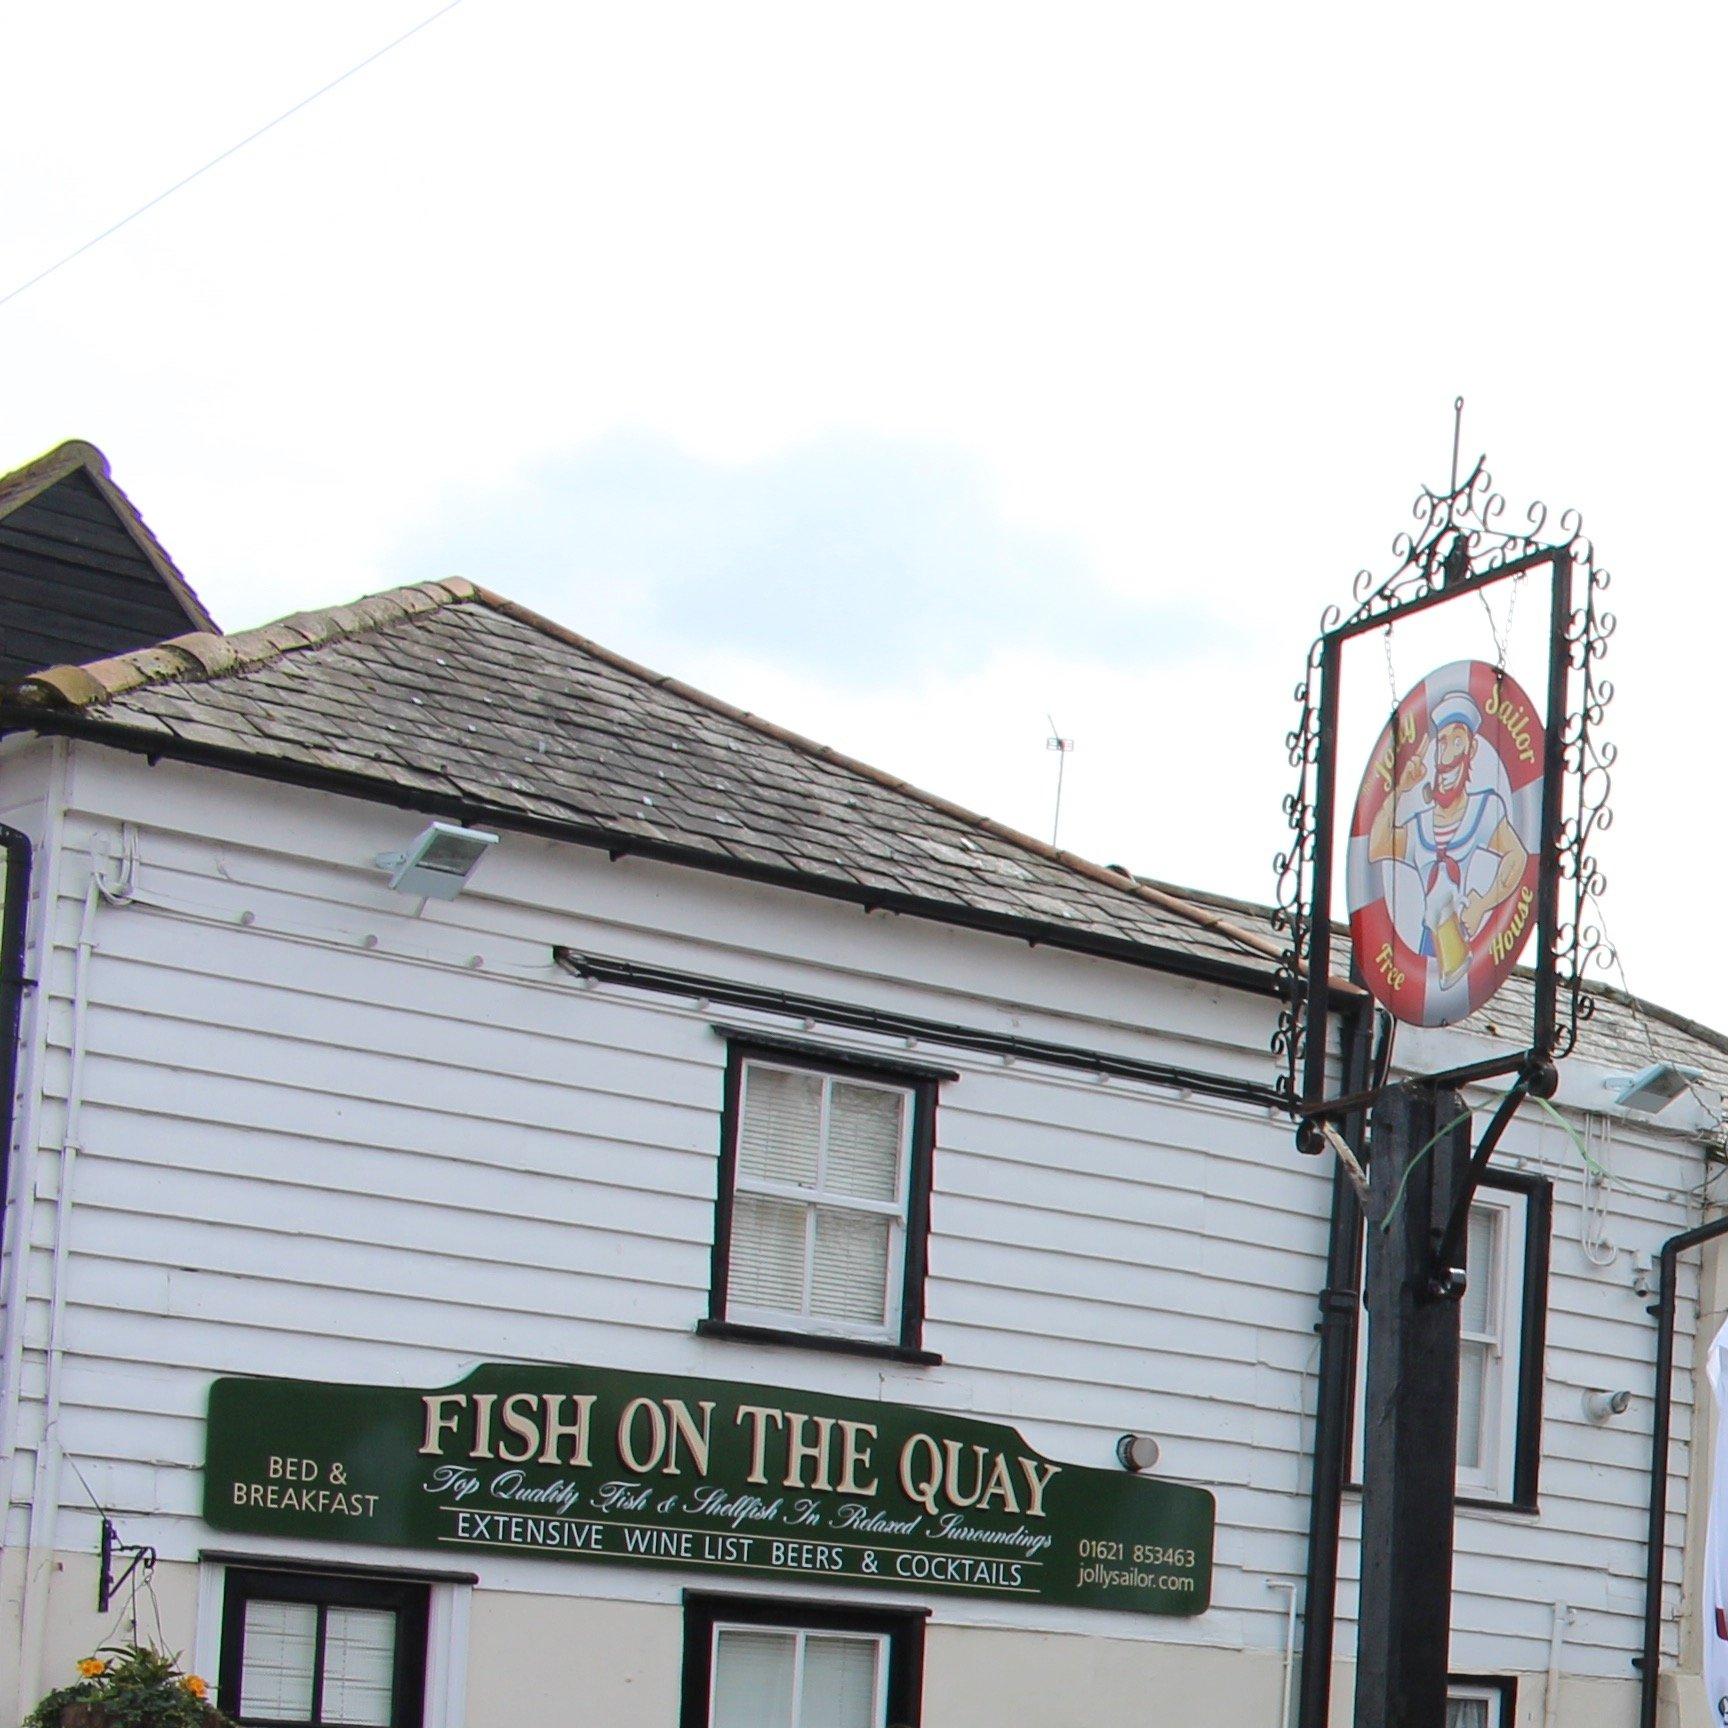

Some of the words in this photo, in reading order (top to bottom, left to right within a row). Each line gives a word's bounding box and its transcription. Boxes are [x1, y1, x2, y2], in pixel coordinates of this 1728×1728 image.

[1374, 711, 1416, 792] Joy
[1485, 683, 1535, 764] Sailor
[1488, 886, 1533, 966] House
[1375, 942, 1405, 991] Free
[269, 1456, 318, 1482] BED
[329, 1462, 347, 1485] &
[418, 1393, 597, 1467] FISH
[618, 1397, 716, 1476] ON
[736, 1404, 879, 1496] THE
[900, 1433, 1062, 1516] QUAY
[233, 1482, 379, 1517] BREAKFAST
[423, 1465, 480, 1500] Top
[490, 1469, 579, 1515] Quality
[590, 1481, 654, 1513] Fish
[657, 1495, 675, 1513] &
[683, 1486, 783, 1529] Shellfish
[783, 1499, 822, 1526] In
[828, 1503, 922, 1535] Relaxed
[926, 1513, 1052, 1558] Surroundings
[457, 1512, 603, 1550] EXTENSIVE
[624, 1528, 693, 1558] WINE
[704, 1536, 753, 1562] LIST
[771, 1542, 843, 1570] BEERS
[861, 1550, 878, 1574] &
[896, 1554, 1022, 1586] COCKTAILS
[1076, 1563, 1194, 1592] jollysailor.com
[1079, 1539, 1123, 1561] 01621
[1133, 1545, 1195, 1568] 853463
